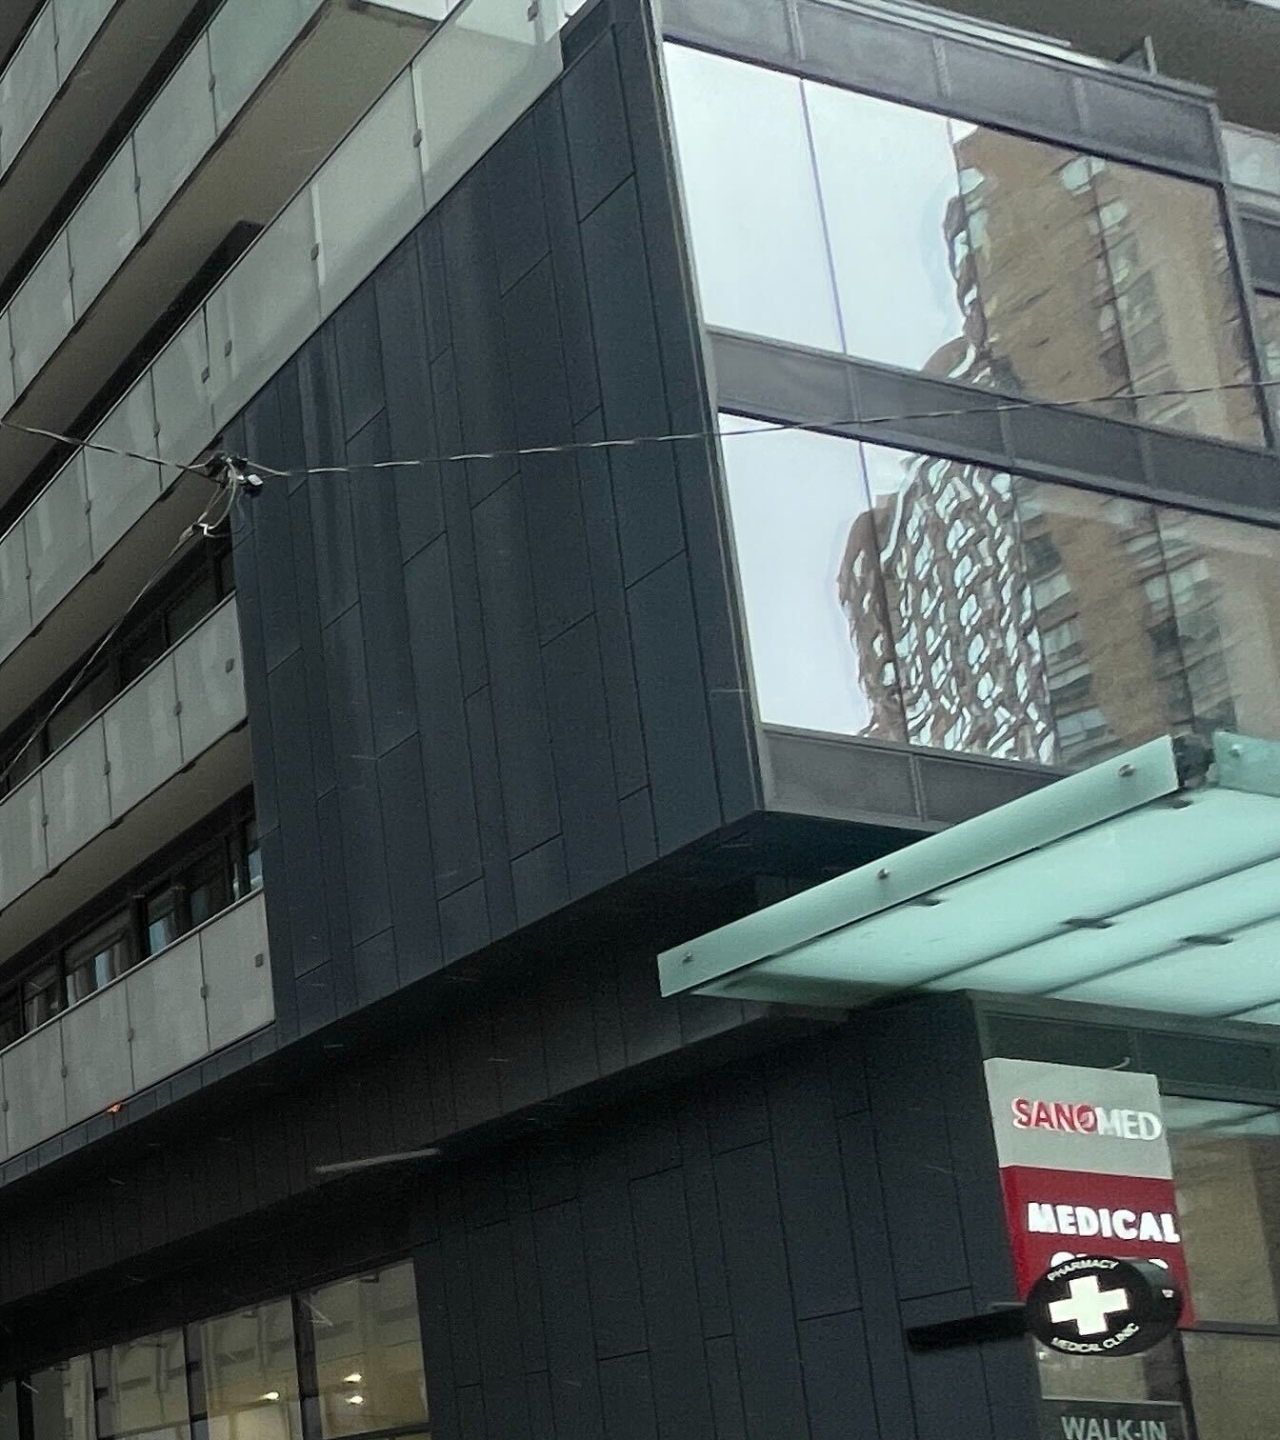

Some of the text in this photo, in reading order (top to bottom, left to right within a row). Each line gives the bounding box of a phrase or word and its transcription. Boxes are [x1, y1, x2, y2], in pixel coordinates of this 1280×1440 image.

[1012, 1097, 1162, 1141] SANOMED
[1027, 1202, 1180, 1243] MEDICAL
[1047, 1260, 1119, 1281] PHARMACY
[1051, 1323, 1140, 1353] MEDICAL CLINIC
